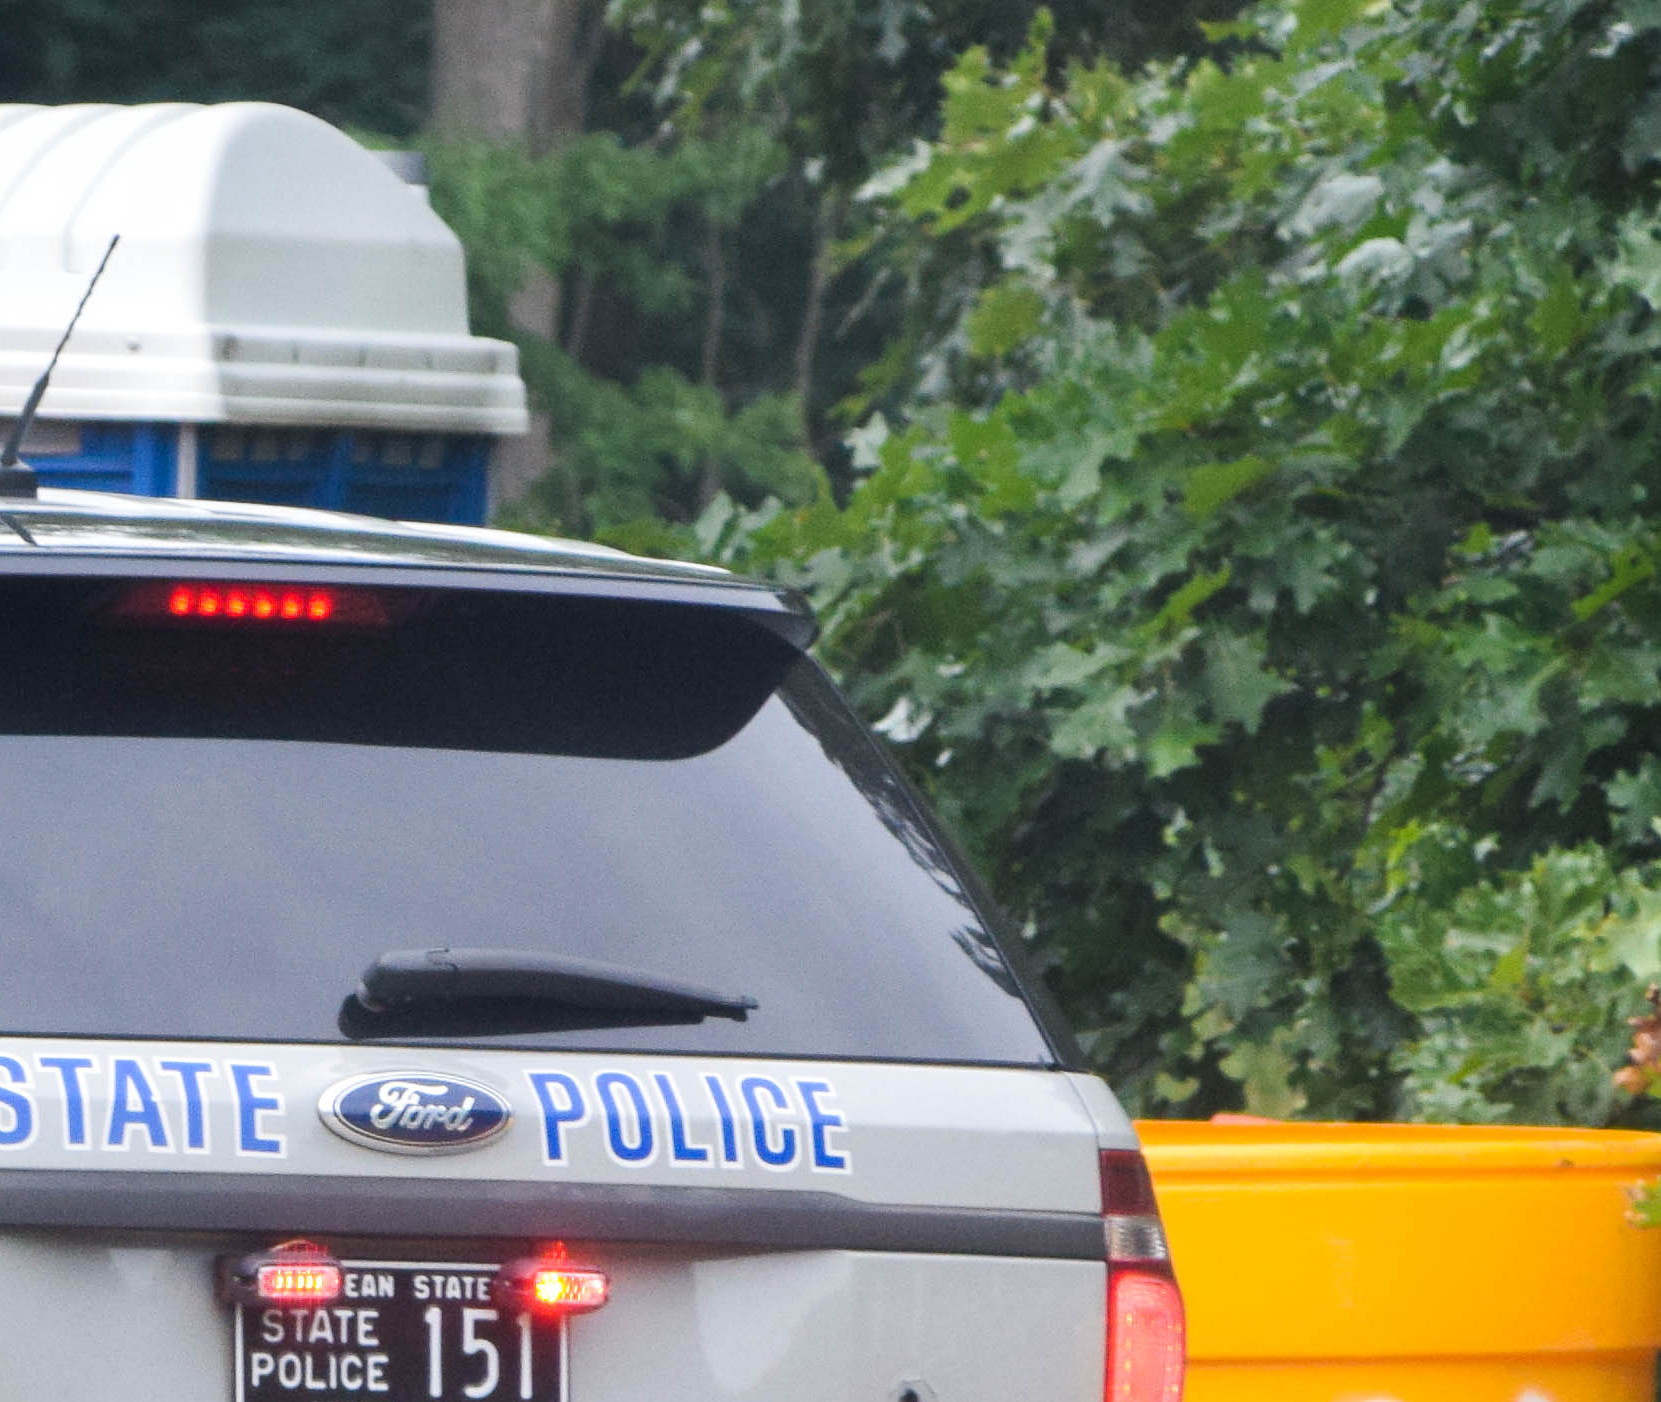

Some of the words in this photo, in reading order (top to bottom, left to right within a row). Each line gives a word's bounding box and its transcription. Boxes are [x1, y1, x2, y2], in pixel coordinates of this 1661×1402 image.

[370, 1081, 476, 1132] Ford
[524, 1068, 854, 1175] POLICE
[344, 1274, 395, 1299] EAN
[414, 1275, 491, 1300] STATE
[263, 1310, 380, 1346] STATE
[250, 1353, 390, 1391] POLICE
[424, 1306, 534, 1400] 151
